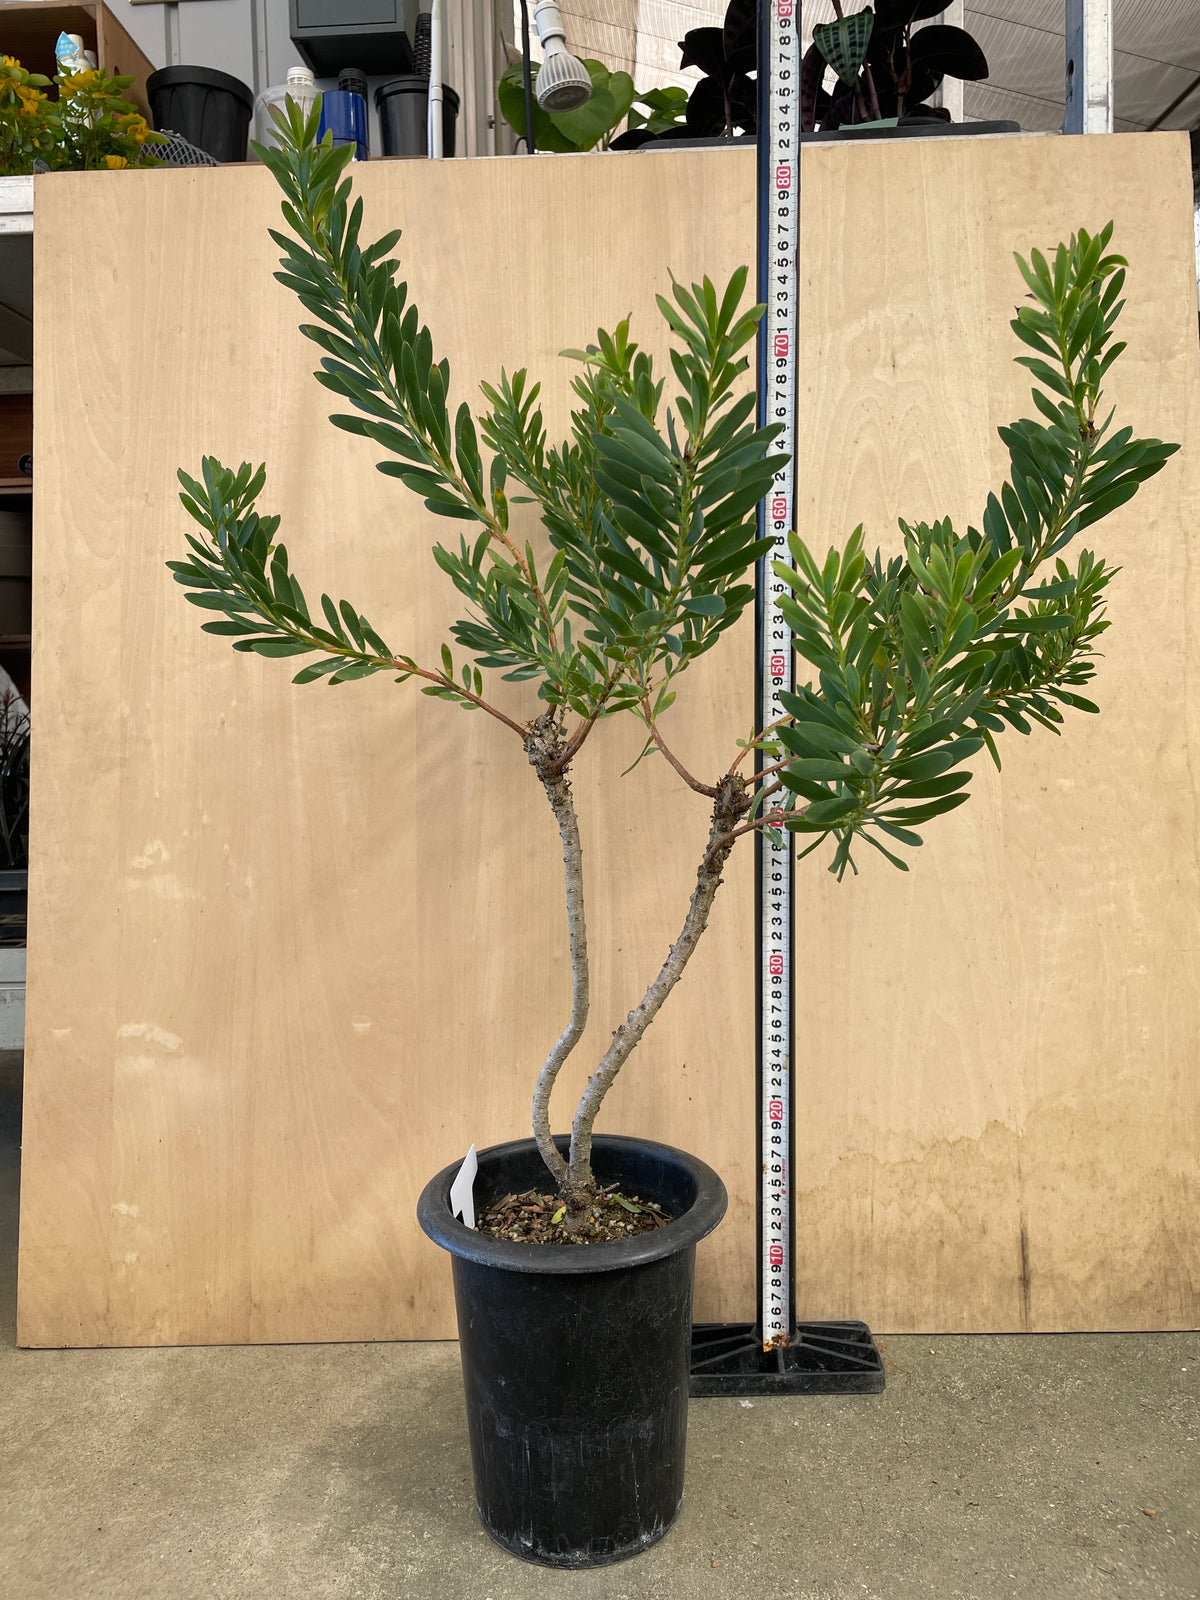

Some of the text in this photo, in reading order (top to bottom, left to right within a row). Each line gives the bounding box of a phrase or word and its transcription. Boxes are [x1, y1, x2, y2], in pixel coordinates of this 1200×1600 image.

[780, 18, 791, 28] 9
[779, 36, 791, 45] 8
[780, 53, 790, 63] 7
[779, 70, 790, 80] 6
[779, 88, 790, 97] 5
[779, 104, 790, 114] 4
[778, 122, 790, 131] 3
[778, 139, 790, 148] 2
[778, 169, 789, 186] 80
[778, 190, 789, 200] 9
[778, 207, 789, 217] 8
[778, 224, 789, 234] 7
[778, 241, 789, 251] 6
[778, 258, 788, 267] 5
[777, 275, 788, 284] 4
[777, 292, 788, 301] 3
[776, 308, 788, 317] 2
[776, 337, 787, 354] 70
[776, 358, 787, 367] 9
[776, 374, 787, 384] 8
[776, 391, 786, 400] 7
[775, 407, 786, 417] 6
[775, 440, 786, 449] 4
[774, 472, 786, 481] 2
[774, 500, 785, 516] 60
[774, 520, 785, 530] 9
[774, 536, 784, 545] 8
[773, 584, 784, 592] 5
[773, 615, 784, 624] 3
[772, 631, 784, 639] 2
[772, 658, 783, 673] 50
[772, 677, 783, 686] 9
[772, 708, 783, 716] 7
[772, 858, 782, 866] 7
[771, 873, 782, 881] 6
[772, 888, 782, 896] 5
[772, 902, 782, 911] 4
[771, 917, 782, 926] 3
[771, 932, 782, 940] 2
[771, 957, 782, 972] 30
[771, 976, 782, 984] 9
[771, 991, 782, 999] 8
[772, 1005, 782, 1013] 7
[771, 1020, 782, 1028] 6
[772, 1034, 782, 1042] 5
[772, 1049, 782, 1057] 4
[771, 1064, 782, 1072] 3
[771, 1078, 782, 1086] 2
[771, 1103, 781, 1118] 20
[771, 1121, 782, 1129] 9
[771, 1136, 782, 1144] 8
[771, 1150, 781, 1158] 7
[771, 1165, 782, 1173] 6
[771, 1179, 782, 1187] 5
[771, 1193, 782, 1202] 4
[771, 1208, 782, 1216] 3
[771, 1222, 782, 1230] 2
[771, 1247, 782, 1260] 10
[771, 1265, 782, 1273] 9
[771, 1279, 782, 1287] 8
[771, 1293, 781, 1301] 7
[771, 1307, 782, 1315] 6
[771, 1321, 782, 1330] 5
